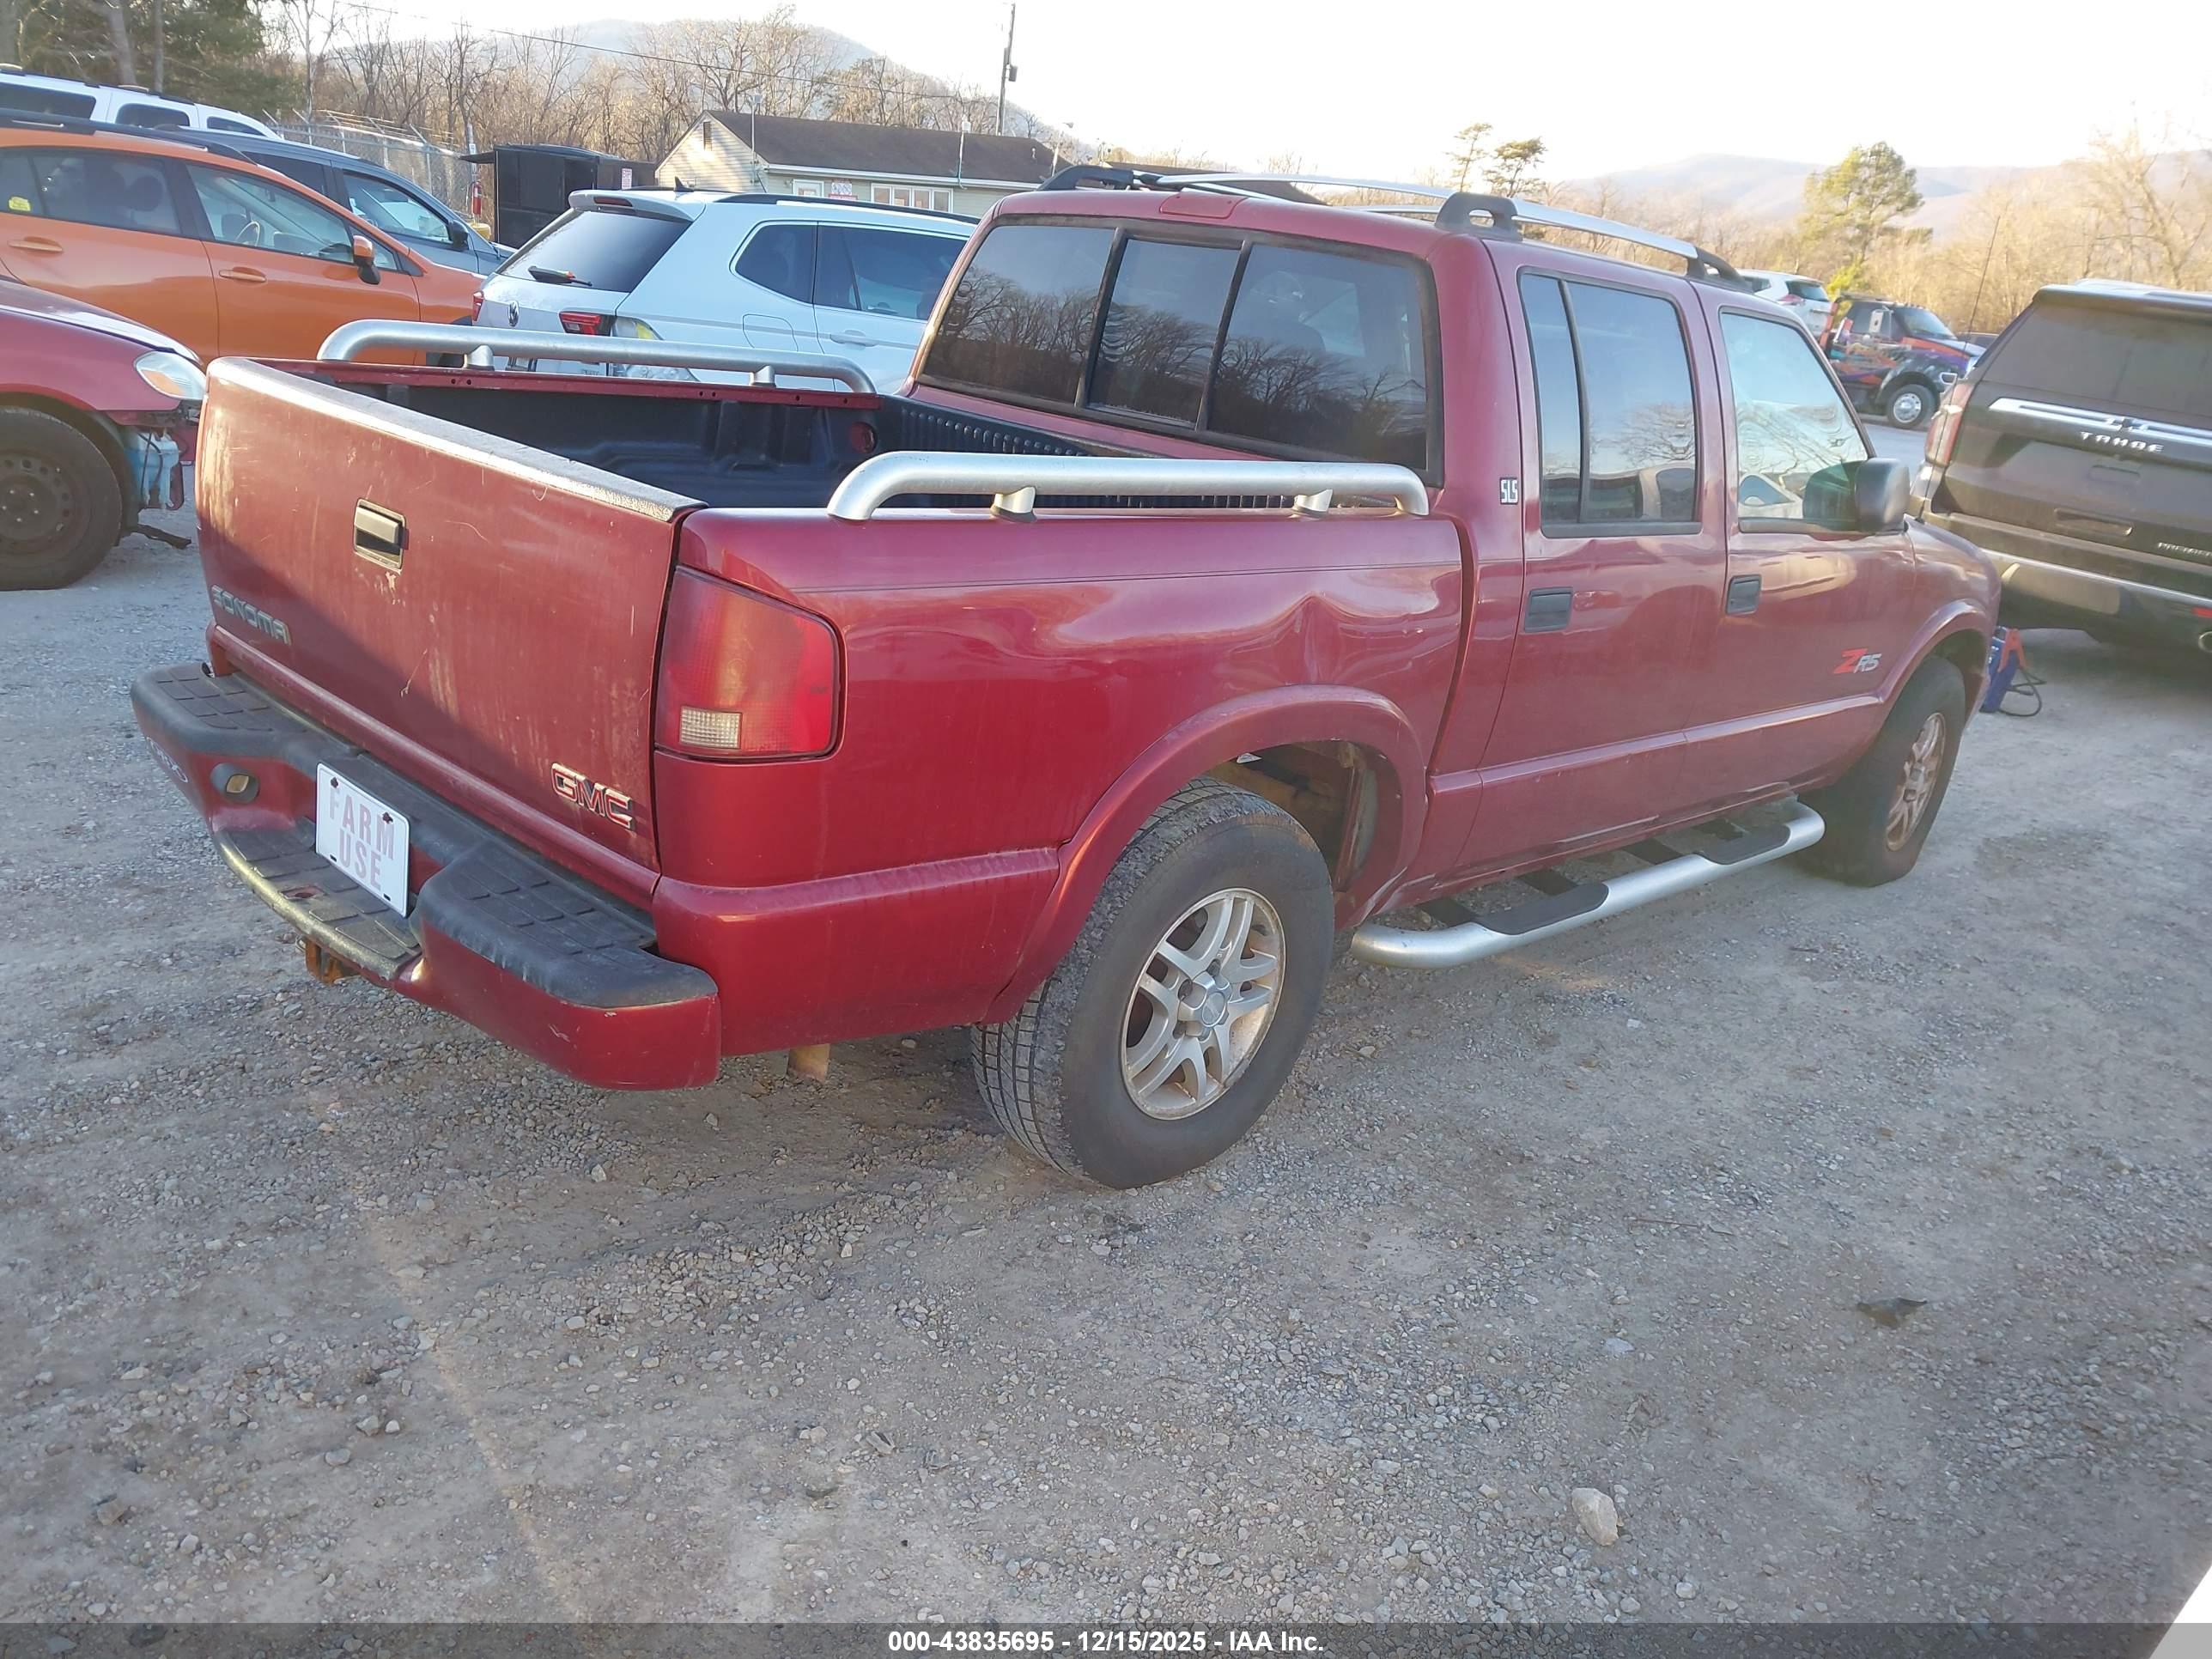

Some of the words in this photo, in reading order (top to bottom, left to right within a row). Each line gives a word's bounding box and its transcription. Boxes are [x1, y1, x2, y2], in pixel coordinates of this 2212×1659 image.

[2079, 431, 2165, 453] TAHOE
[1499, 478, 1518, 504] SLS
[211, 584, 291, 646] SONOMA
[330, 786, 395, 861] FARM
[551, 763, 634, 830] GMC
[339, 828, 383, 890] USE
